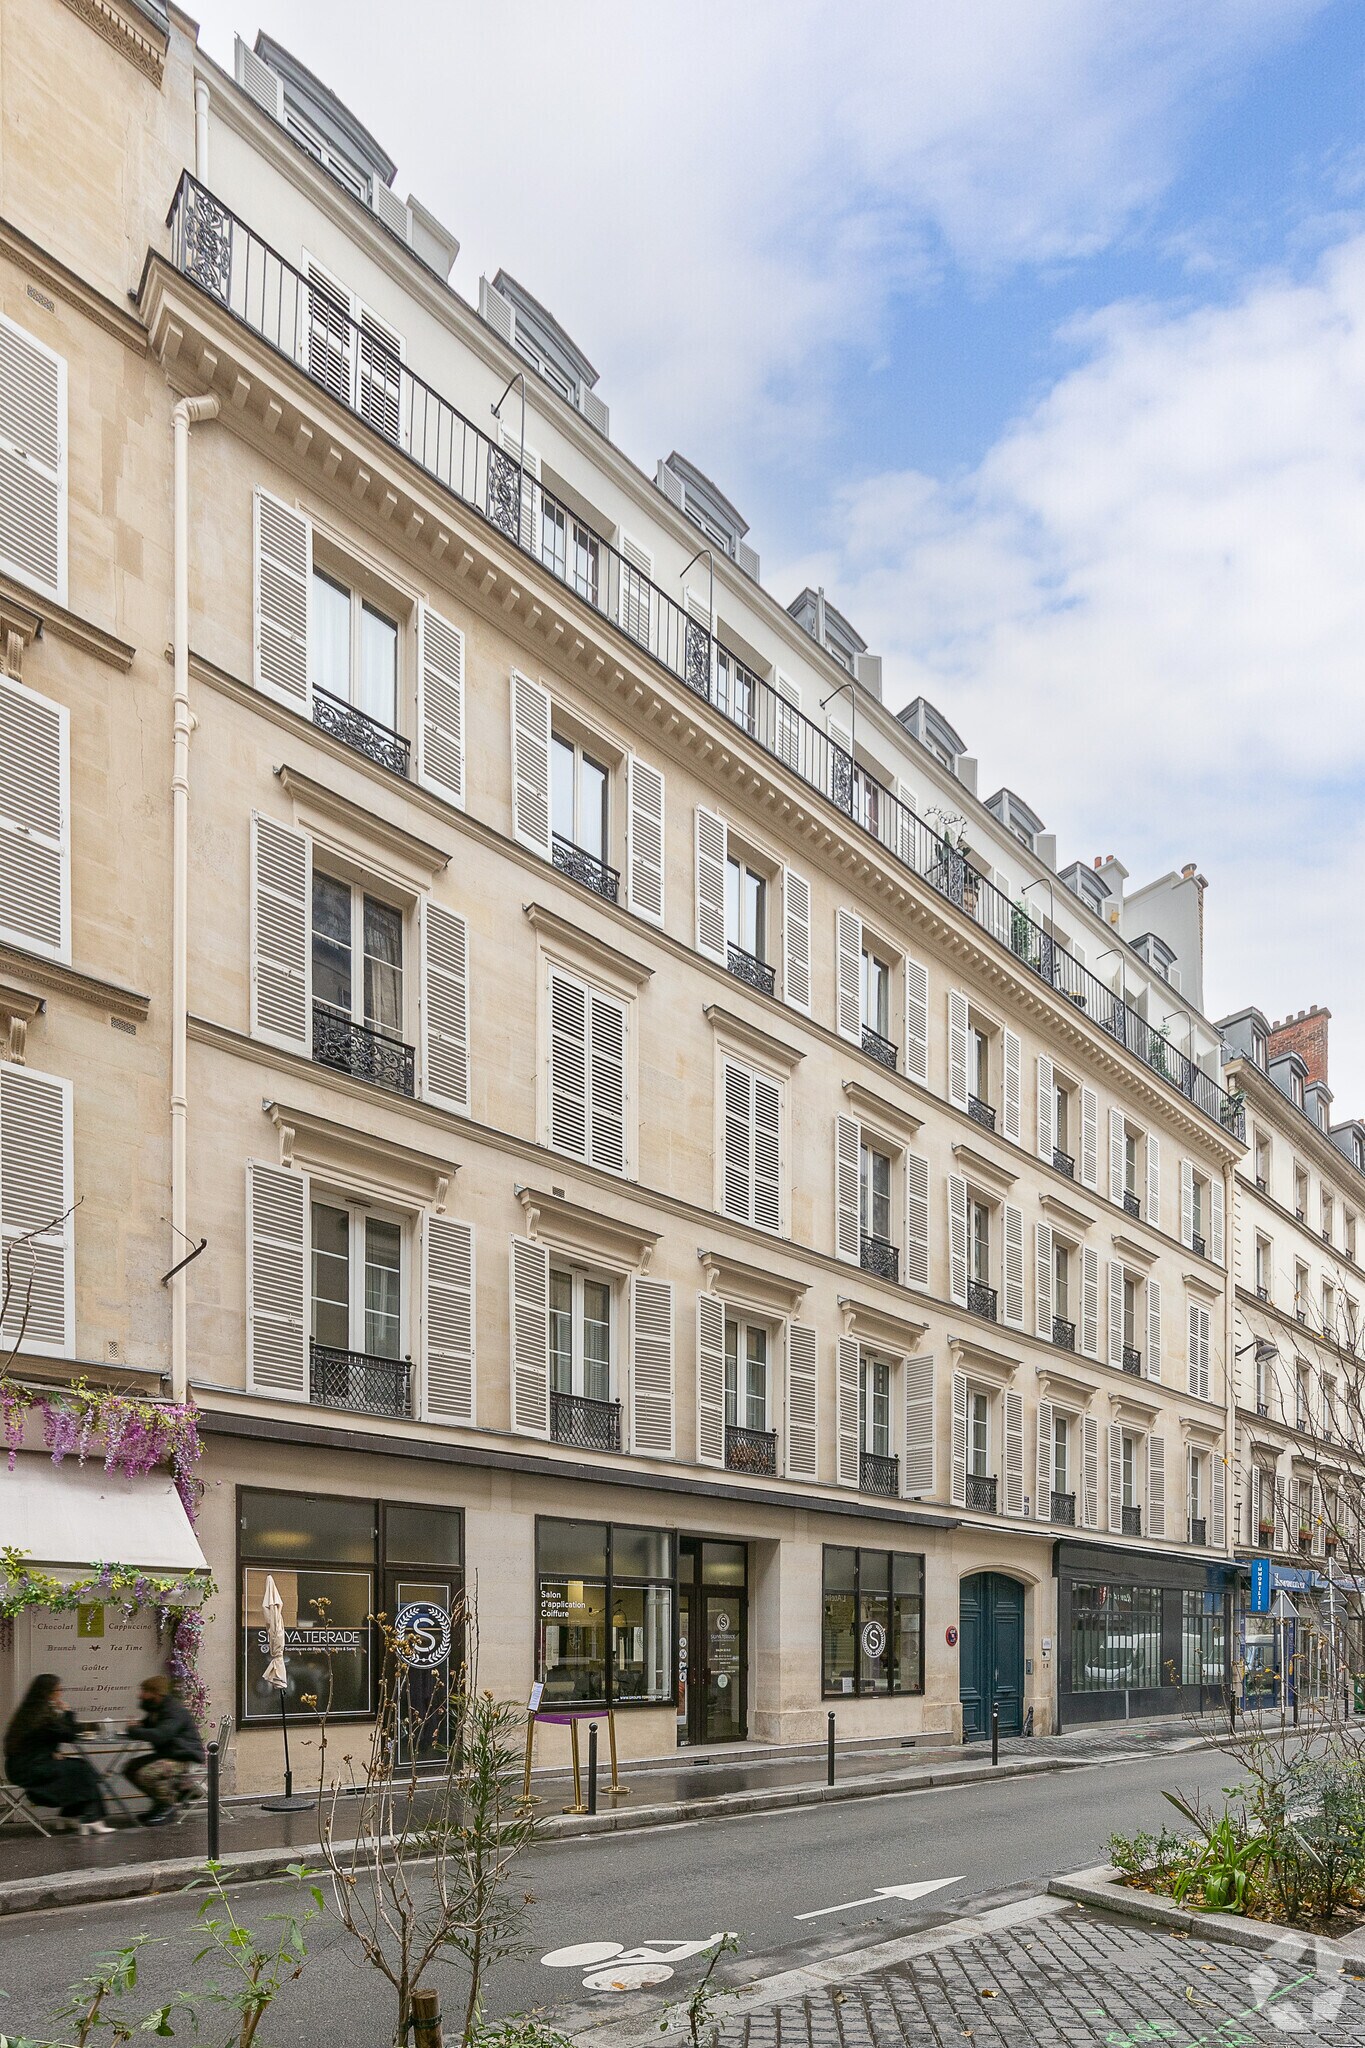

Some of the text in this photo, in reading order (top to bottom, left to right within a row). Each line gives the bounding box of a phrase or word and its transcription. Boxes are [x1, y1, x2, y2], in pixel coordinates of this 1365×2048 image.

[541, 1590, 562, 1599] Salon
[541, 1600, 586, 1609] d'application
[541, 1610, 570, 1618] Coiffure
[108, 1623, 152, 1632] Cappuccino
[257, 1630, 360, 1643] SIYA.TERRADE
[81, 1663, 109, 1671] Goûter
[96, 1685, 131, 1693] Déjeuner
